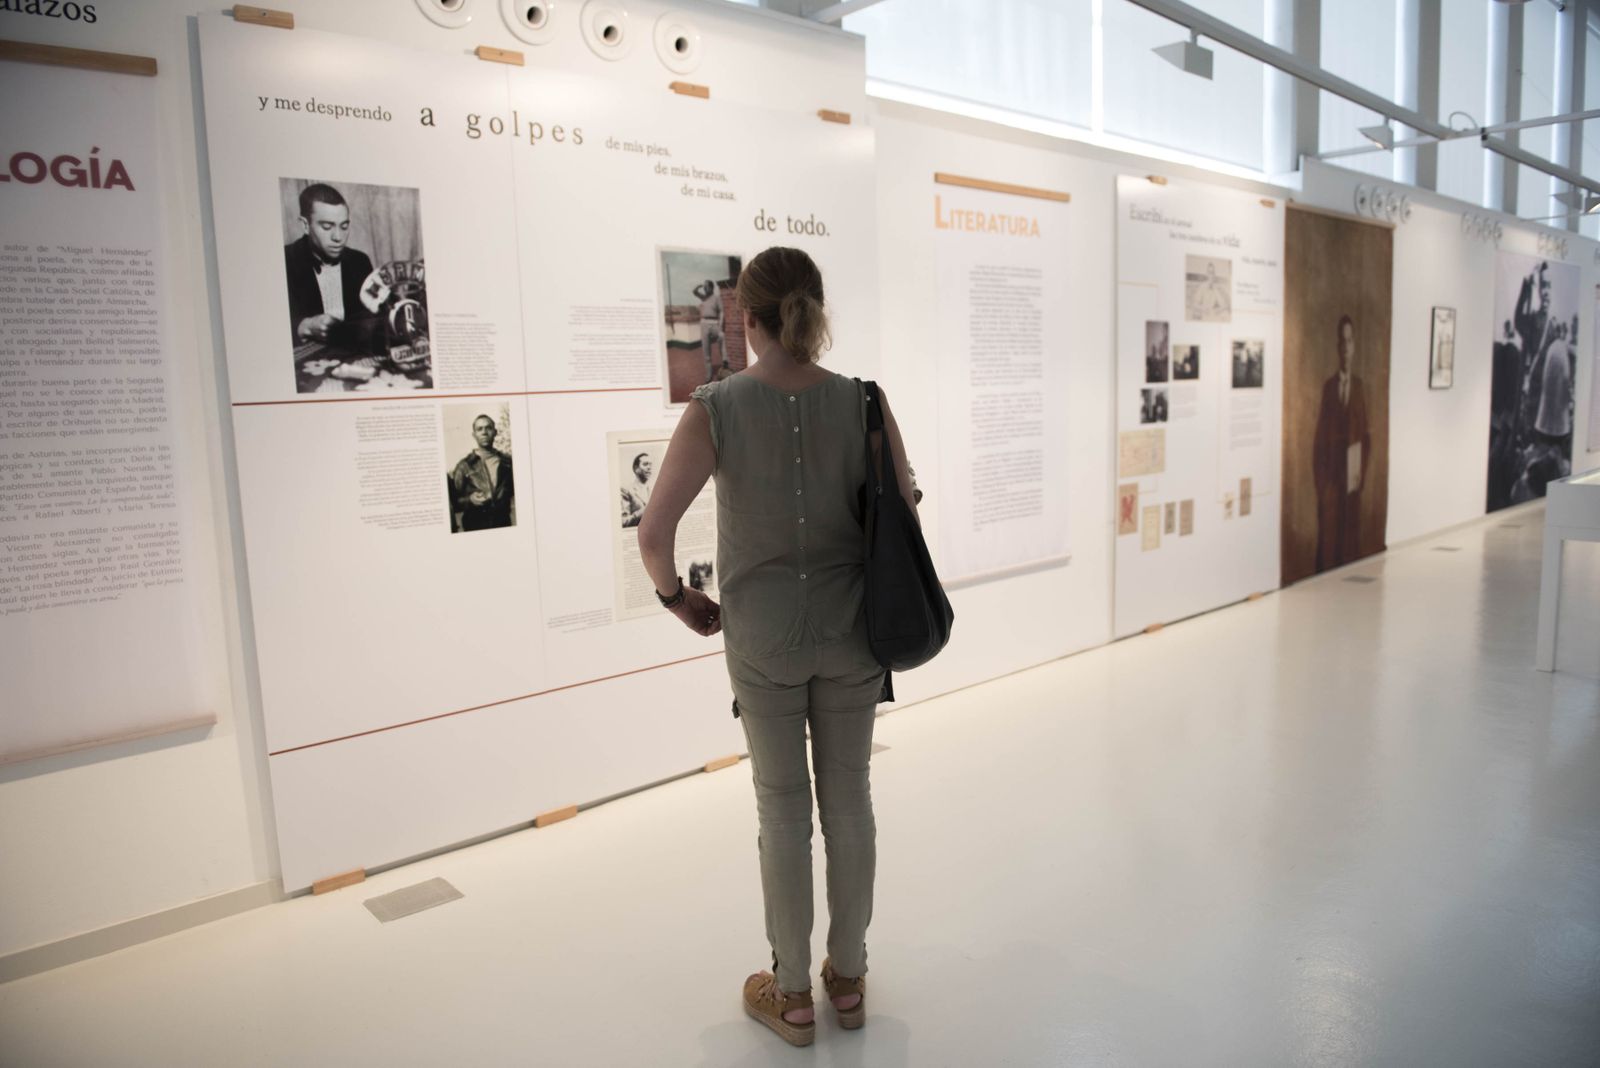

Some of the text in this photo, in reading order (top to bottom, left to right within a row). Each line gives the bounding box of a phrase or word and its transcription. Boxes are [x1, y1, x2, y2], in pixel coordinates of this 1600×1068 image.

[258, 95, 584, 146] y me desprendo a golpes
[605, 137, 620, 149] de
[623, 140, 644, 153] mis
[654, 162, 668, 175] de
[671, 164, 690, 178] mis
[681, 184, 695, 196] de
[697, 185, 711, 198] mi
[754, 209, 831, 237] de todo.
